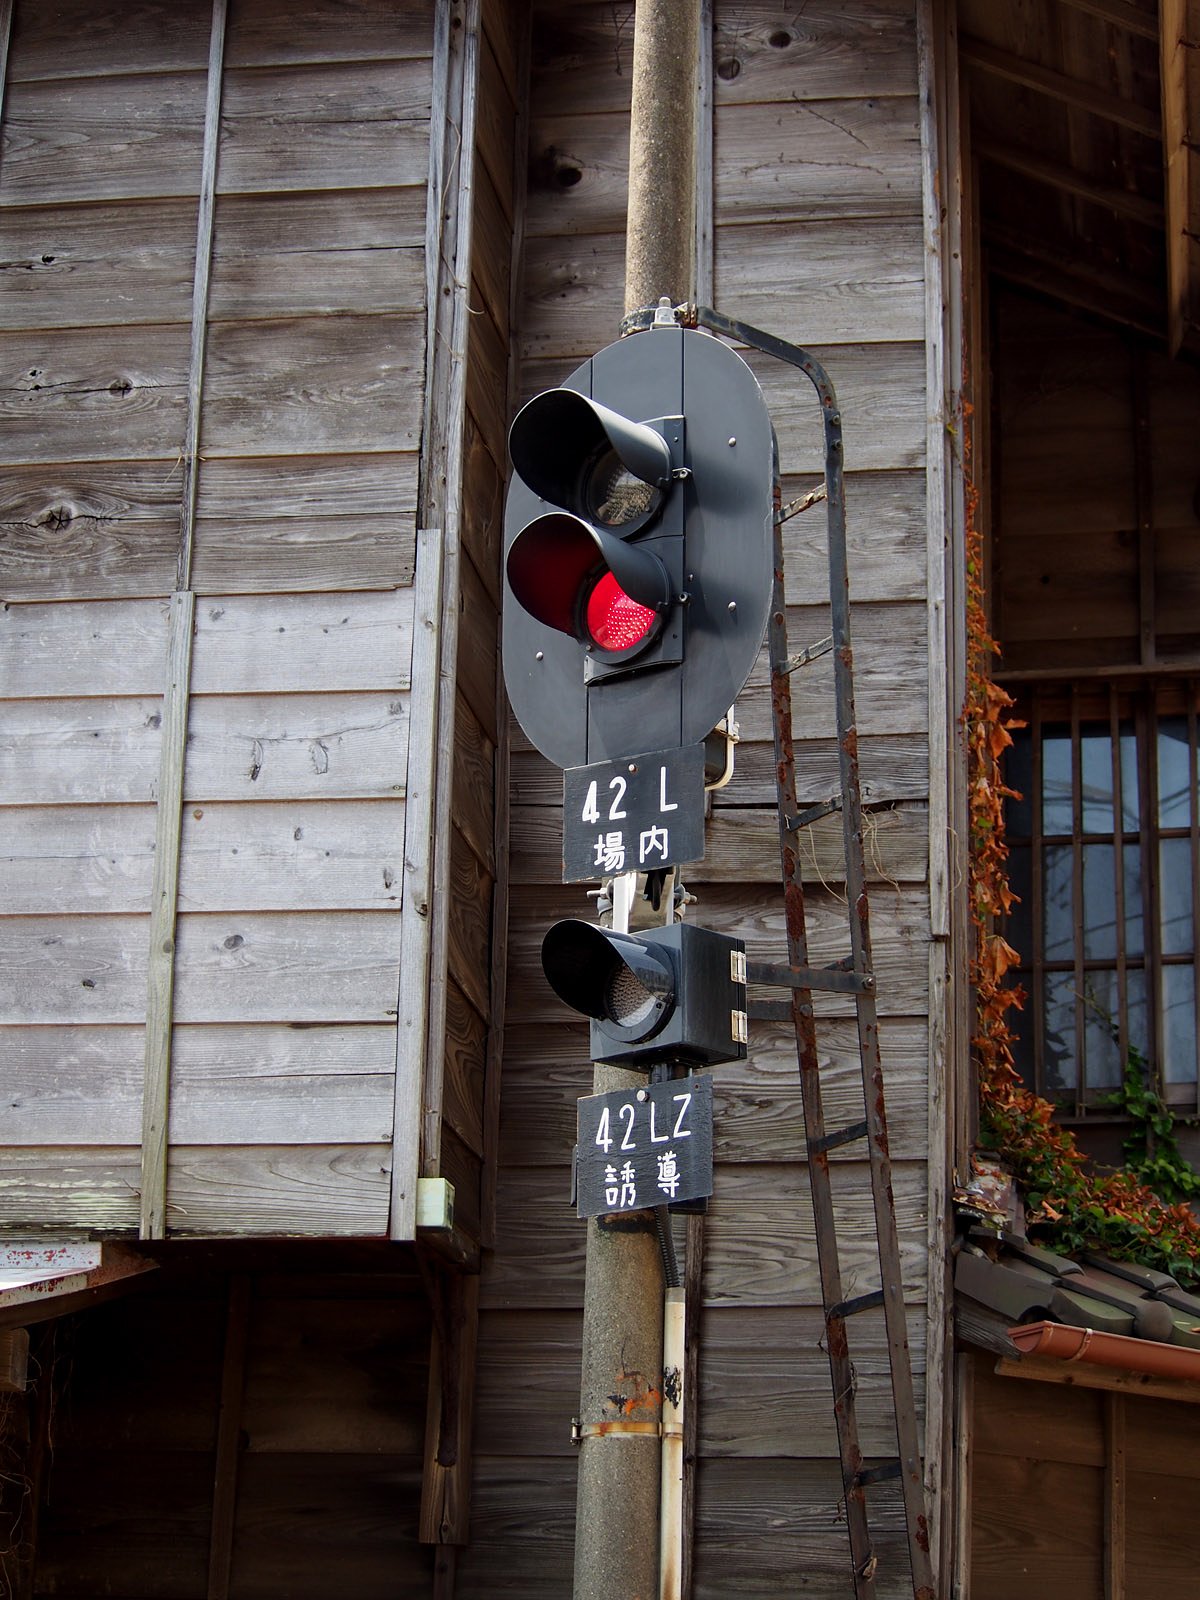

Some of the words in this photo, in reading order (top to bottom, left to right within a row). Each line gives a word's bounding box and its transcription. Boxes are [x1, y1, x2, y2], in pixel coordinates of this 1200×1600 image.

[582, 776, 627, 824] 42
[660, 766, 678, 812] L
[593, 825, 669, 872] 場内
[604, 1150, 681, 1208] 誘導
